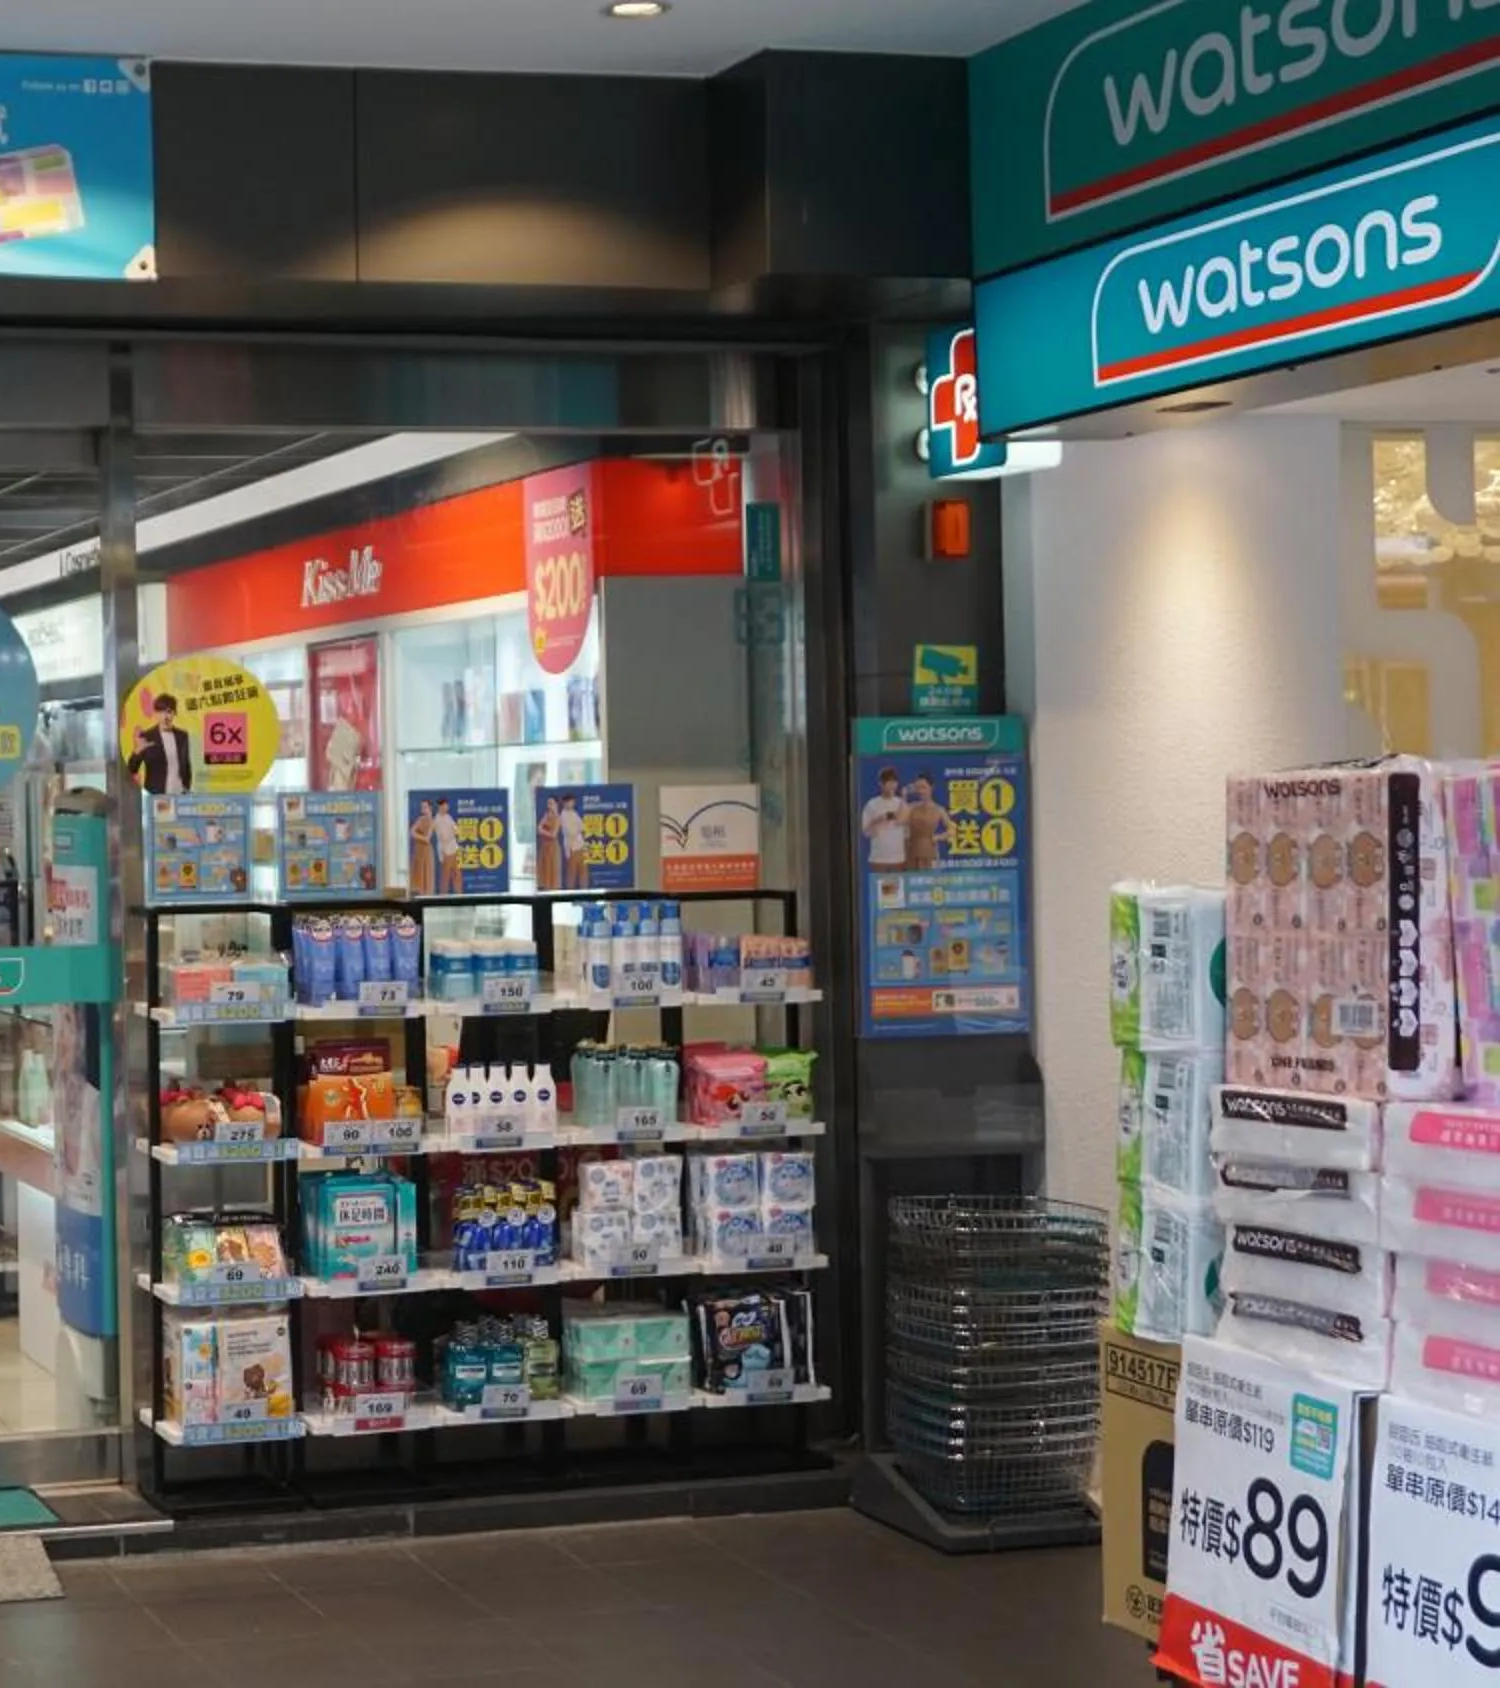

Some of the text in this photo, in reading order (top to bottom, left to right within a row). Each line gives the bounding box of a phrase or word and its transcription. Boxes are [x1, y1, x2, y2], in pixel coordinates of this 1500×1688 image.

[1104, 0, 1500, 146] watso
[1138, 194, 1442, 335] watsons
[210, 722, 243, 745] 6x
[898, 723, 983, 743] watsons
[1262, 779, 1342, 799] watsons
[375, 1263, 400, 1276] 240
[1185, 1397, 1275, 1453] 單串原價$119
[1180, 1476, 1329, 1600] 特價$89
[1190, 1620, 1227, 1685] 省
[1227, 1650, 1300, 1688] SAVE
